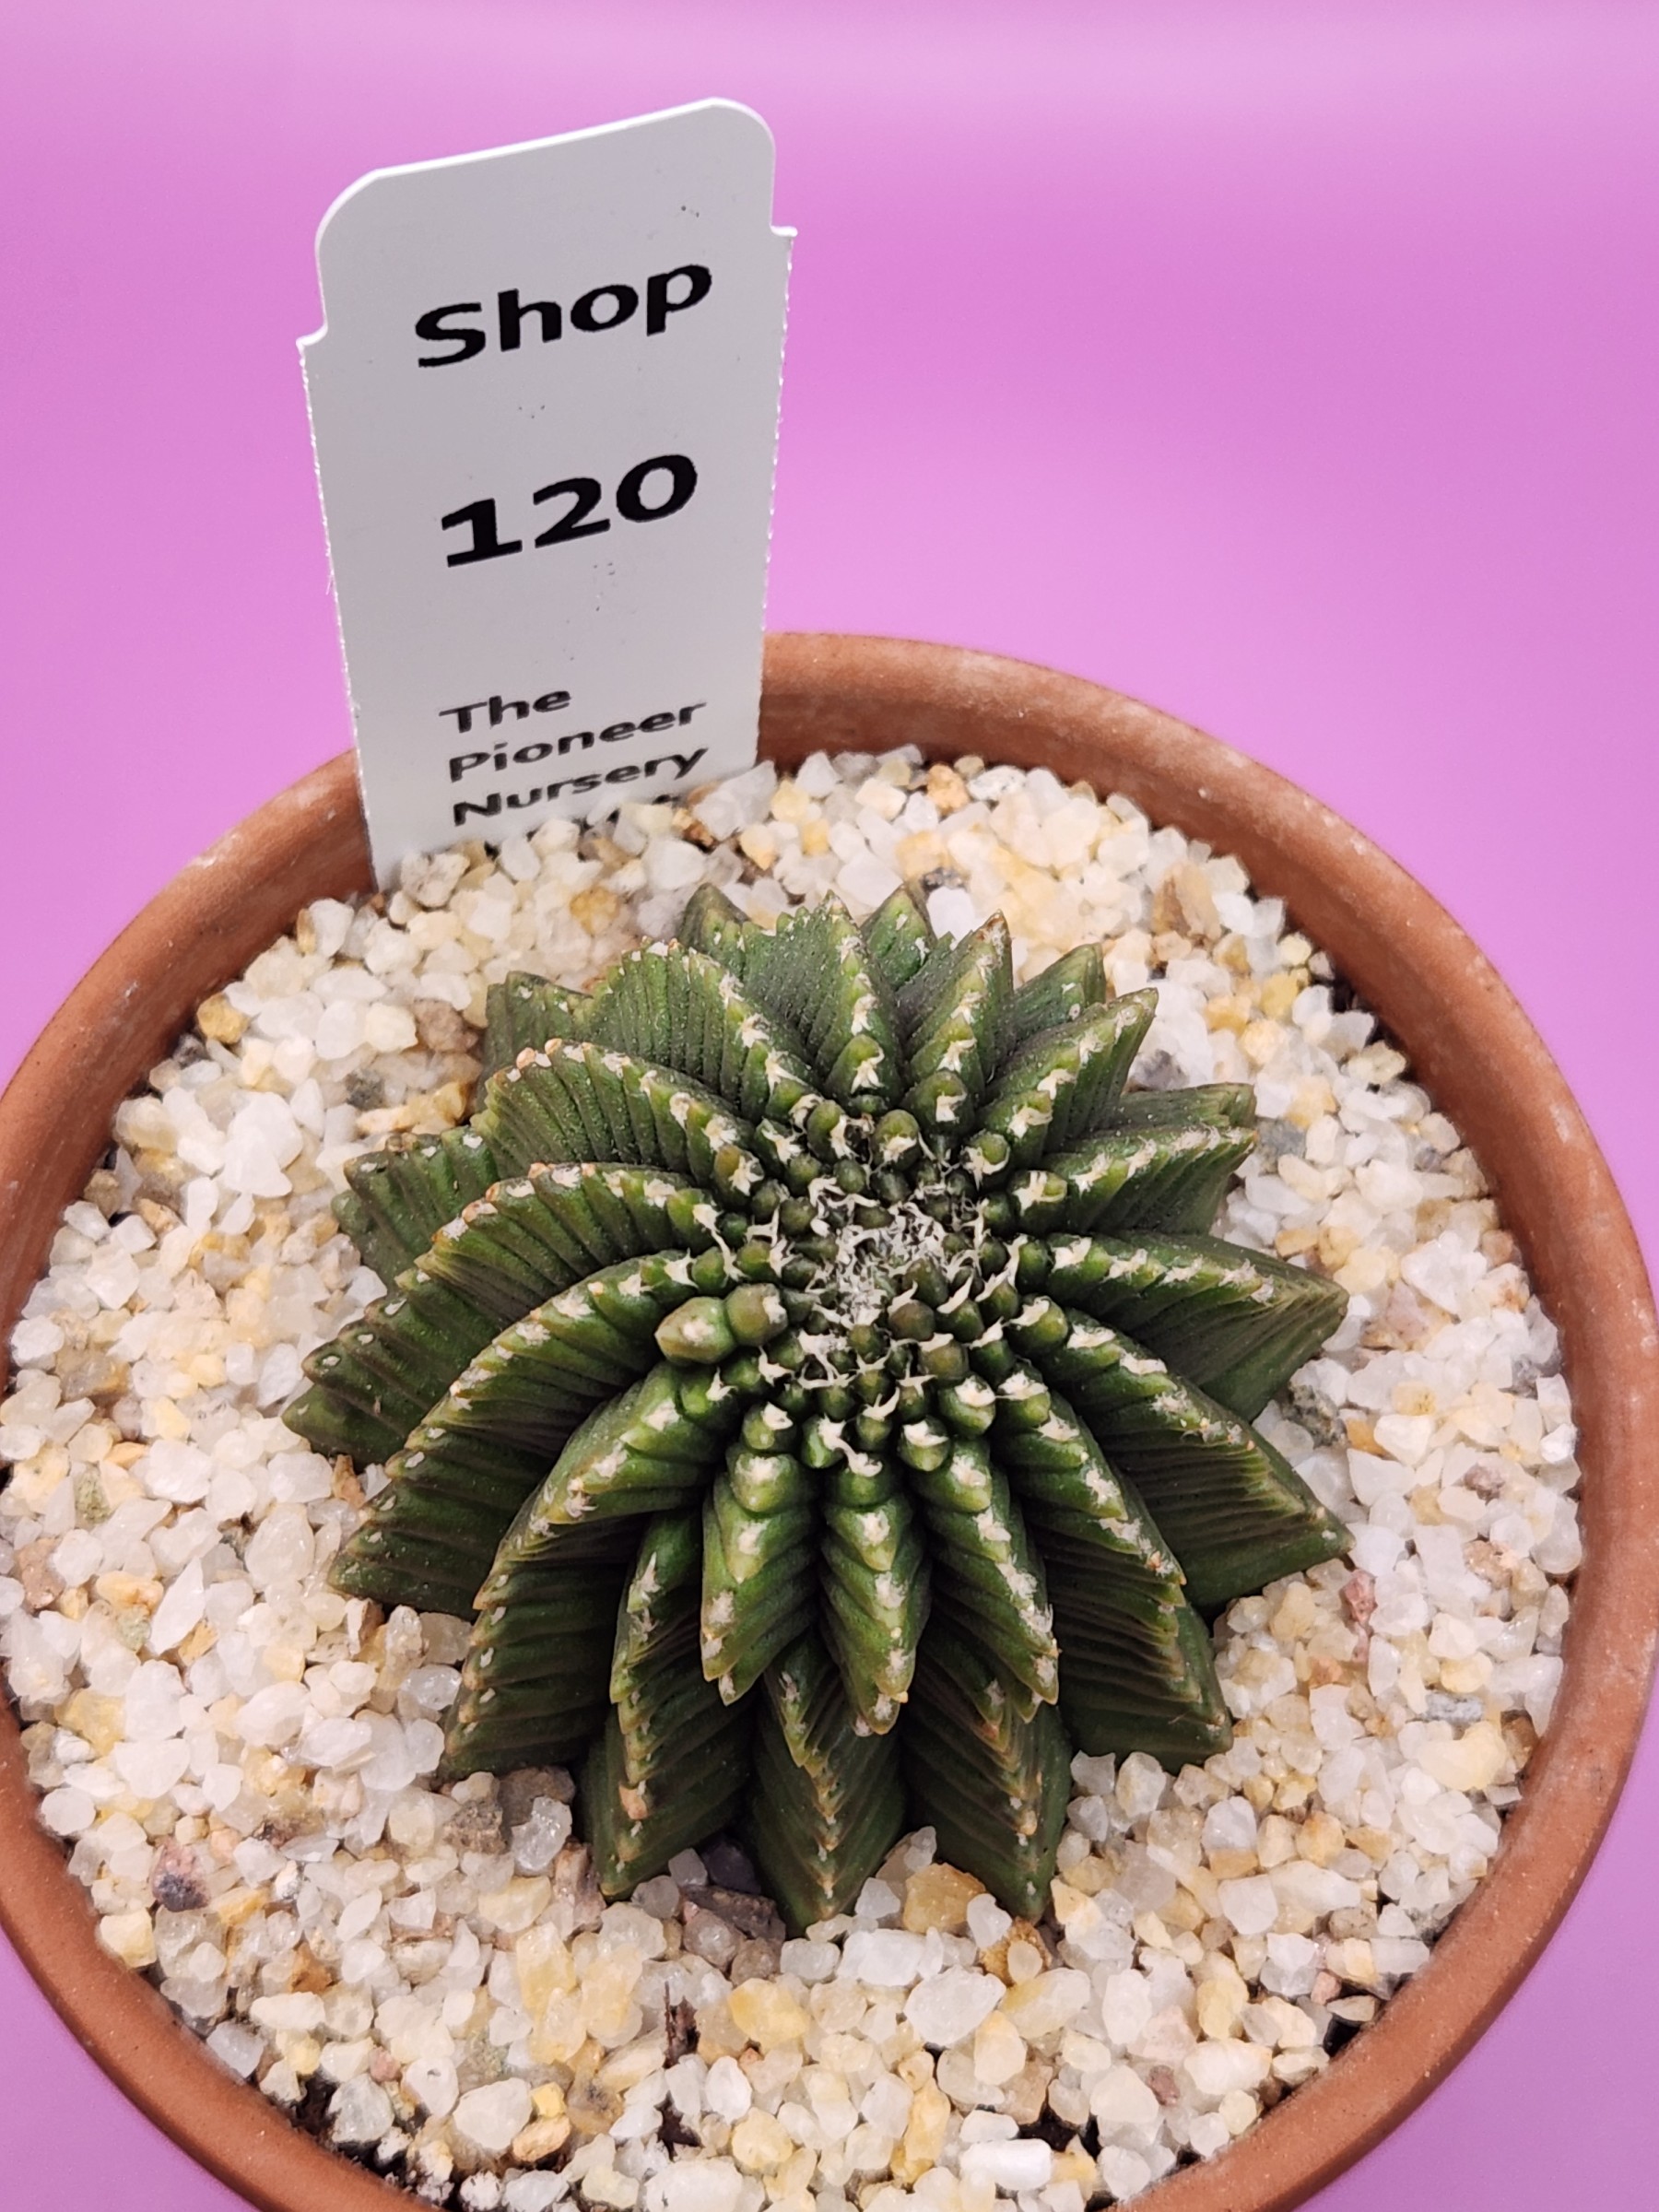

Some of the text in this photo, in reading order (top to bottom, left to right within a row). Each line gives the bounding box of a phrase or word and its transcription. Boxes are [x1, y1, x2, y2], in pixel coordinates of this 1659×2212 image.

[416, 265, 712, 368] Shop
[441, 454, 698, 567] 120
[440, 689, 571, 734] The
[450, 702, 708, 782] Pioneer
[453, 748, 708, 827] Nursery
